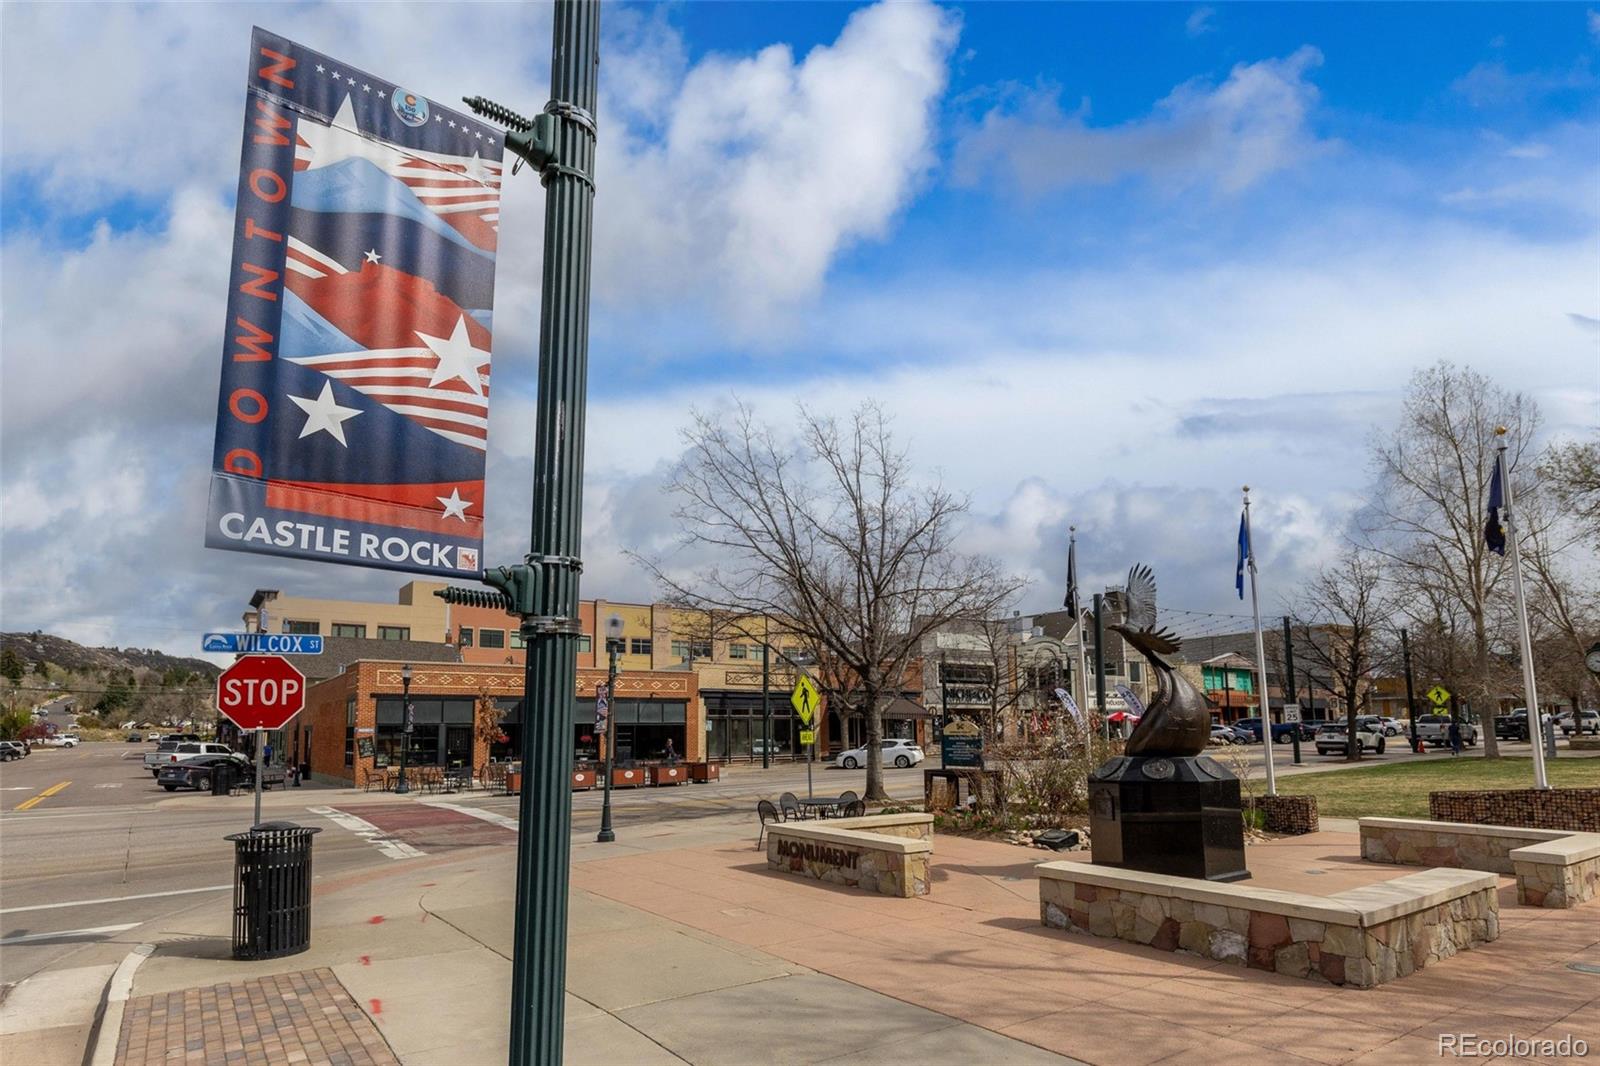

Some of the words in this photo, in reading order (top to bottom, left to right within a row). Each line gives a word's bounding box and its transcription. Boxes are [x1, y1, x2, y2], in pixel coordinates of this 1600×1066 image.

[224, 47, 297, 479] DOWNTOWN
[219, 512, 349, 554] CASTLE
[360, 532, 454, 568] ROCK
[236, 635, 303, 652] WILCOX
[310, 640, 319, 649] ST
[223, 679, 299, 706] STOP
[1287, 713, 1298, 721] 25
[777, 839, 860, 870] MONUMENT
